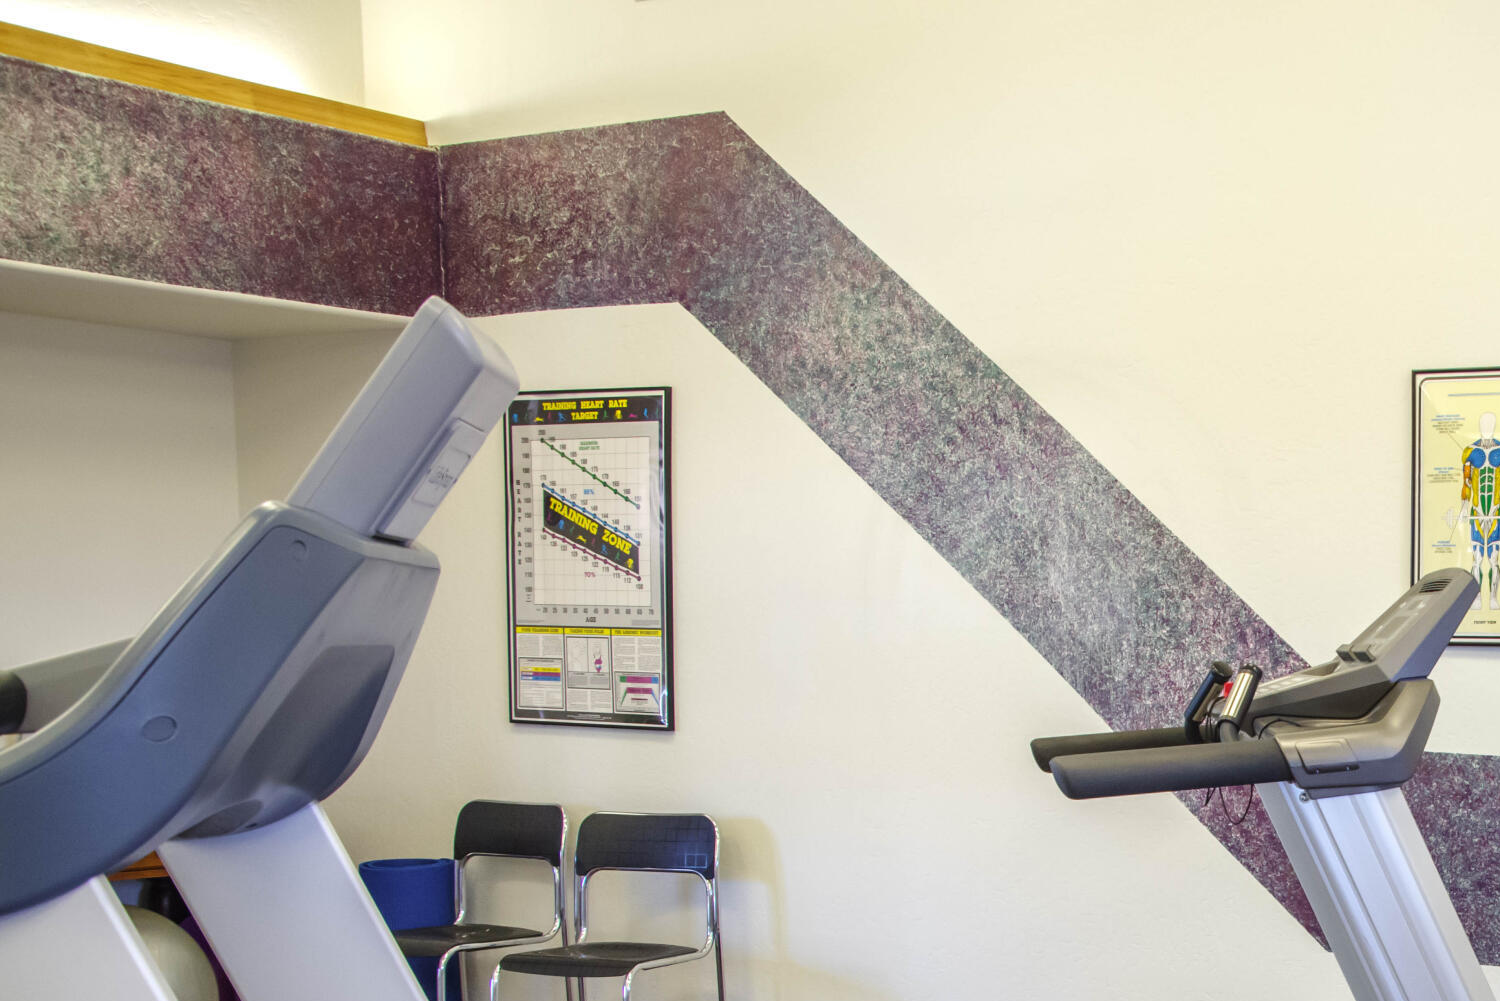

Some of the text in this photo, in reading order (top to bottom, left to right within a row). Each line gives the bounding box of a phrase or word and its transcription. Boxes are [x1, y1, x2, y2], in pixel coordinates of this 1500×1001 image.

[542, 399, 628, 411] TRAINING HEART RATE
[571, 411, 599, 421] TARGET
[549, 497, 632, 555] TRAINING ZONE
